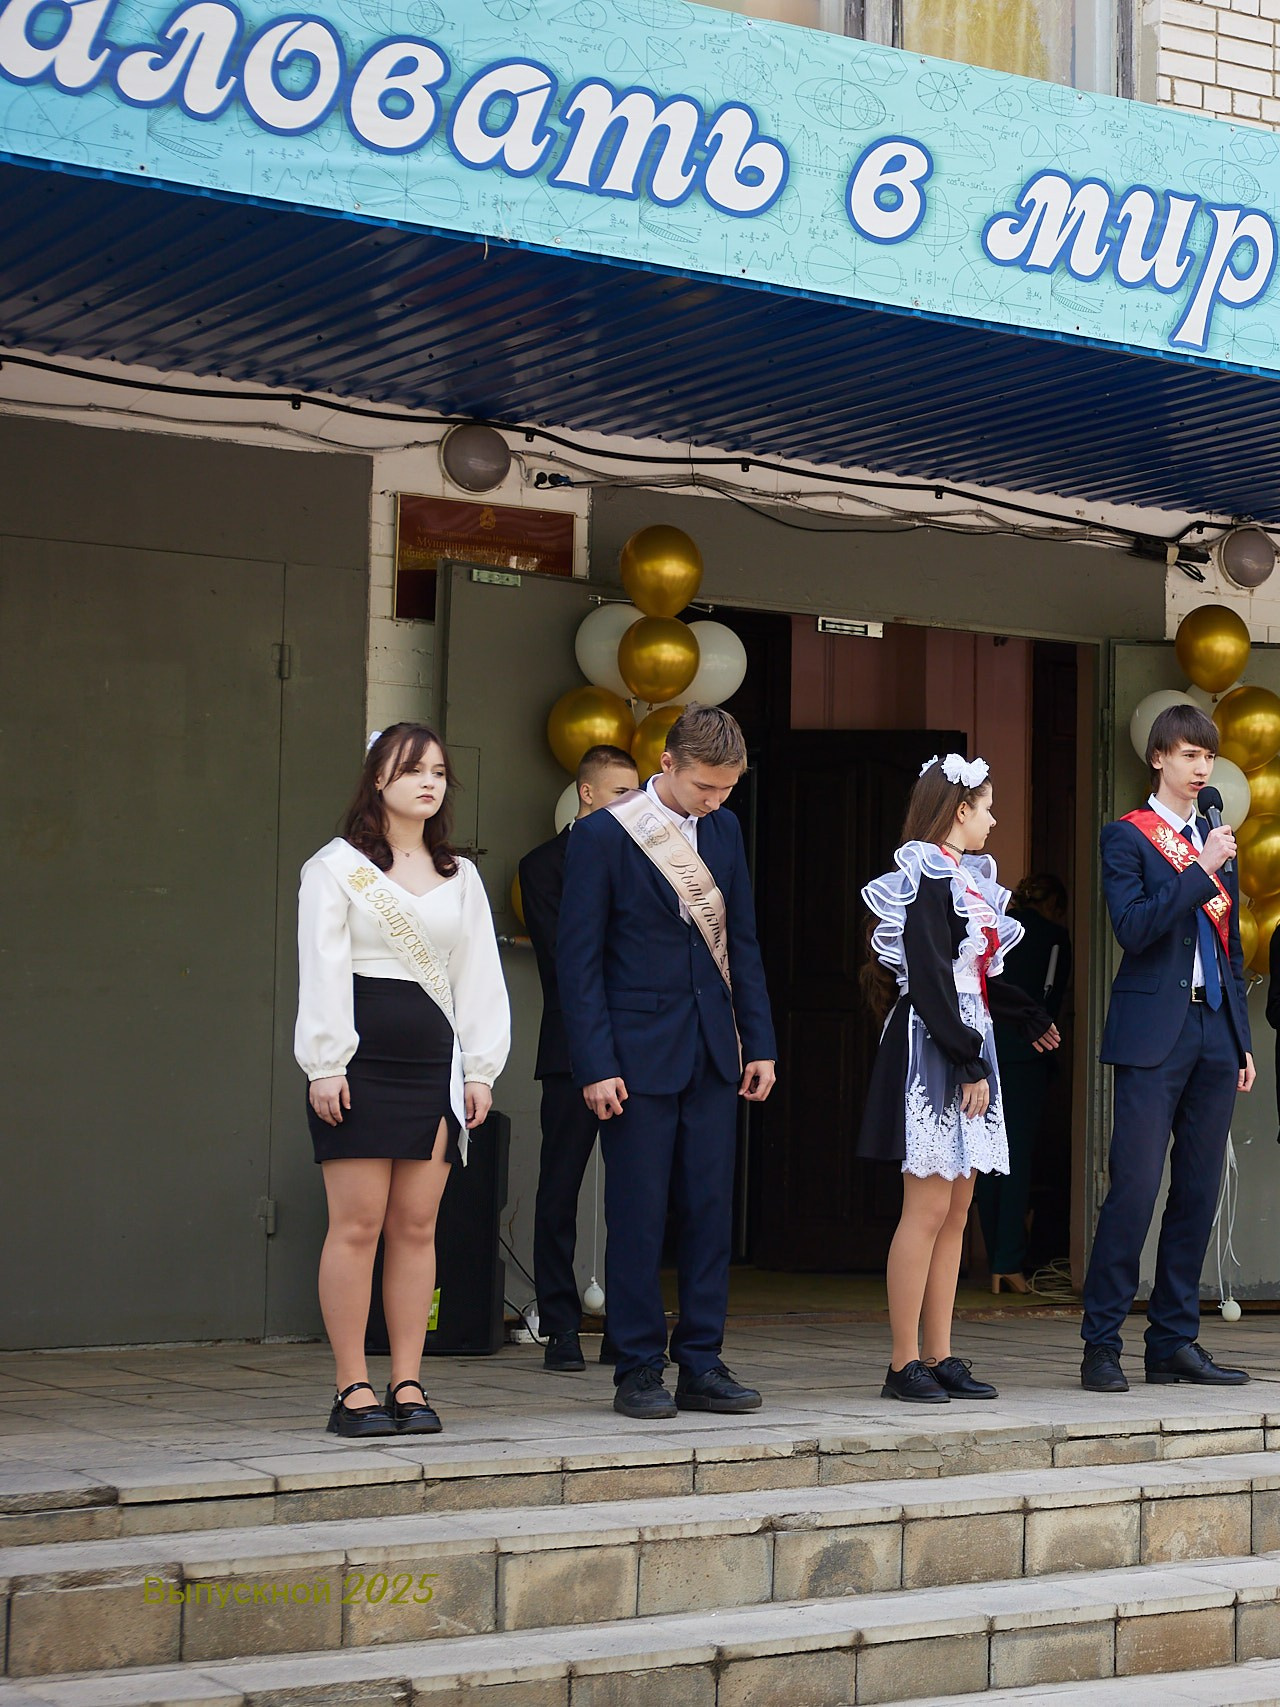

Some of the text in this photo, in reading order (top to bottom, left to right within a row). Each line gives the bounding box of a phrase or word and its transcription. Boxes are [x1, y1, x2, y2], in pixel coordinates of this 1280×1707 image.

[0, 0, 789, 218] аловать
[845, 136, 934, 245] в
[982, 168, 1279, 352] мир
